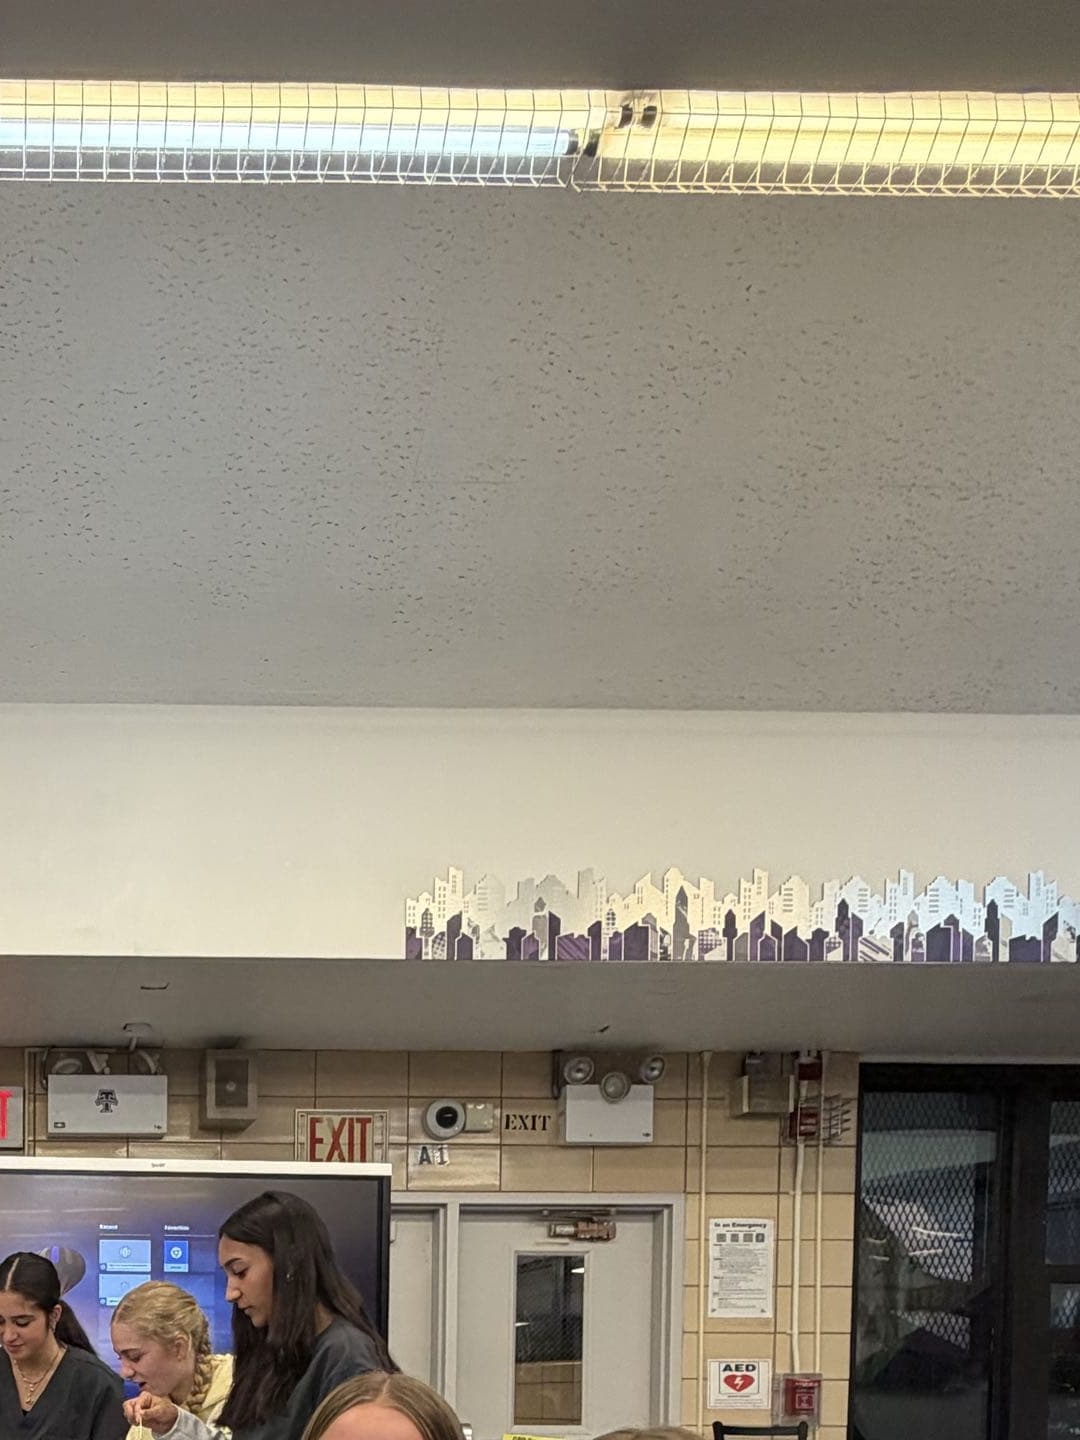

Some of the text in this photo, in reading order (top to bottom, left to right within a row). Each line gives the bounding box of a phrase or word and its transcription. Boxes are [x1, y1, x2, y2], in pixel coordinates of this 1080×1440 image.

[504, 1114, 551, 1131] EXIT
[309, 1117, 372, 1163] EXIT
[722, 1364, 757, 1372] AED
